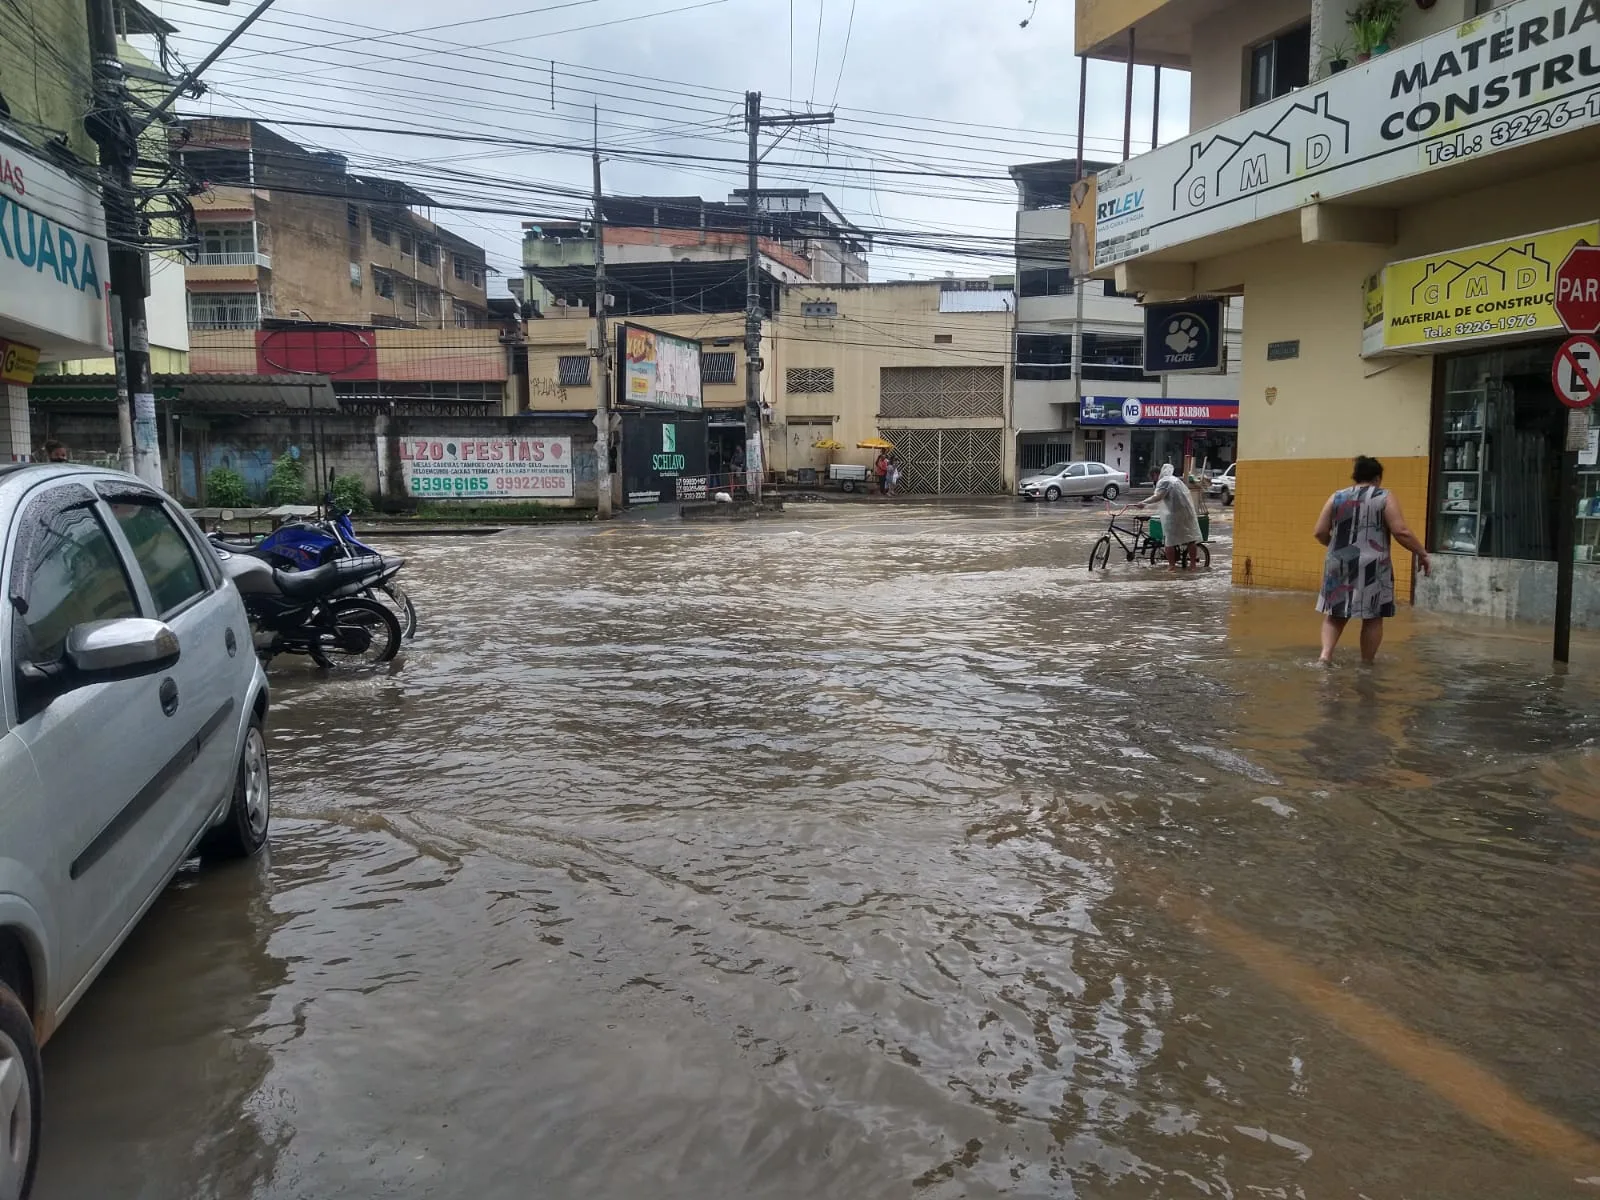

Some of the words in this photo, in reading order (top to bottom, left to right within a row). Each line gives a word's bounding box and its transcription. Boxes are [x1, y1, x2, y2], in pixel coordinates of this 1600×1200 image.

[1426, 134, 1482, 165] Tel.:
[1391, 309, 1450, 327] MATERIAL
[1455, 305, 1471, 318] DE
[1424, 324, 1451, 339] Tel.:
[1455, 313, 1537, 336] 3226-1976
[1164, 352, 1195, 364] TIGRE
[1125, 404, 1139, 417] MB
[1145, 406, 1178, 418] MAGAZINE
[1179, 406, 1211, 419] BARBOSA
[461, 440, 545, 462] FESTAS
[652, 454, 685, 471] SCHIAVO
